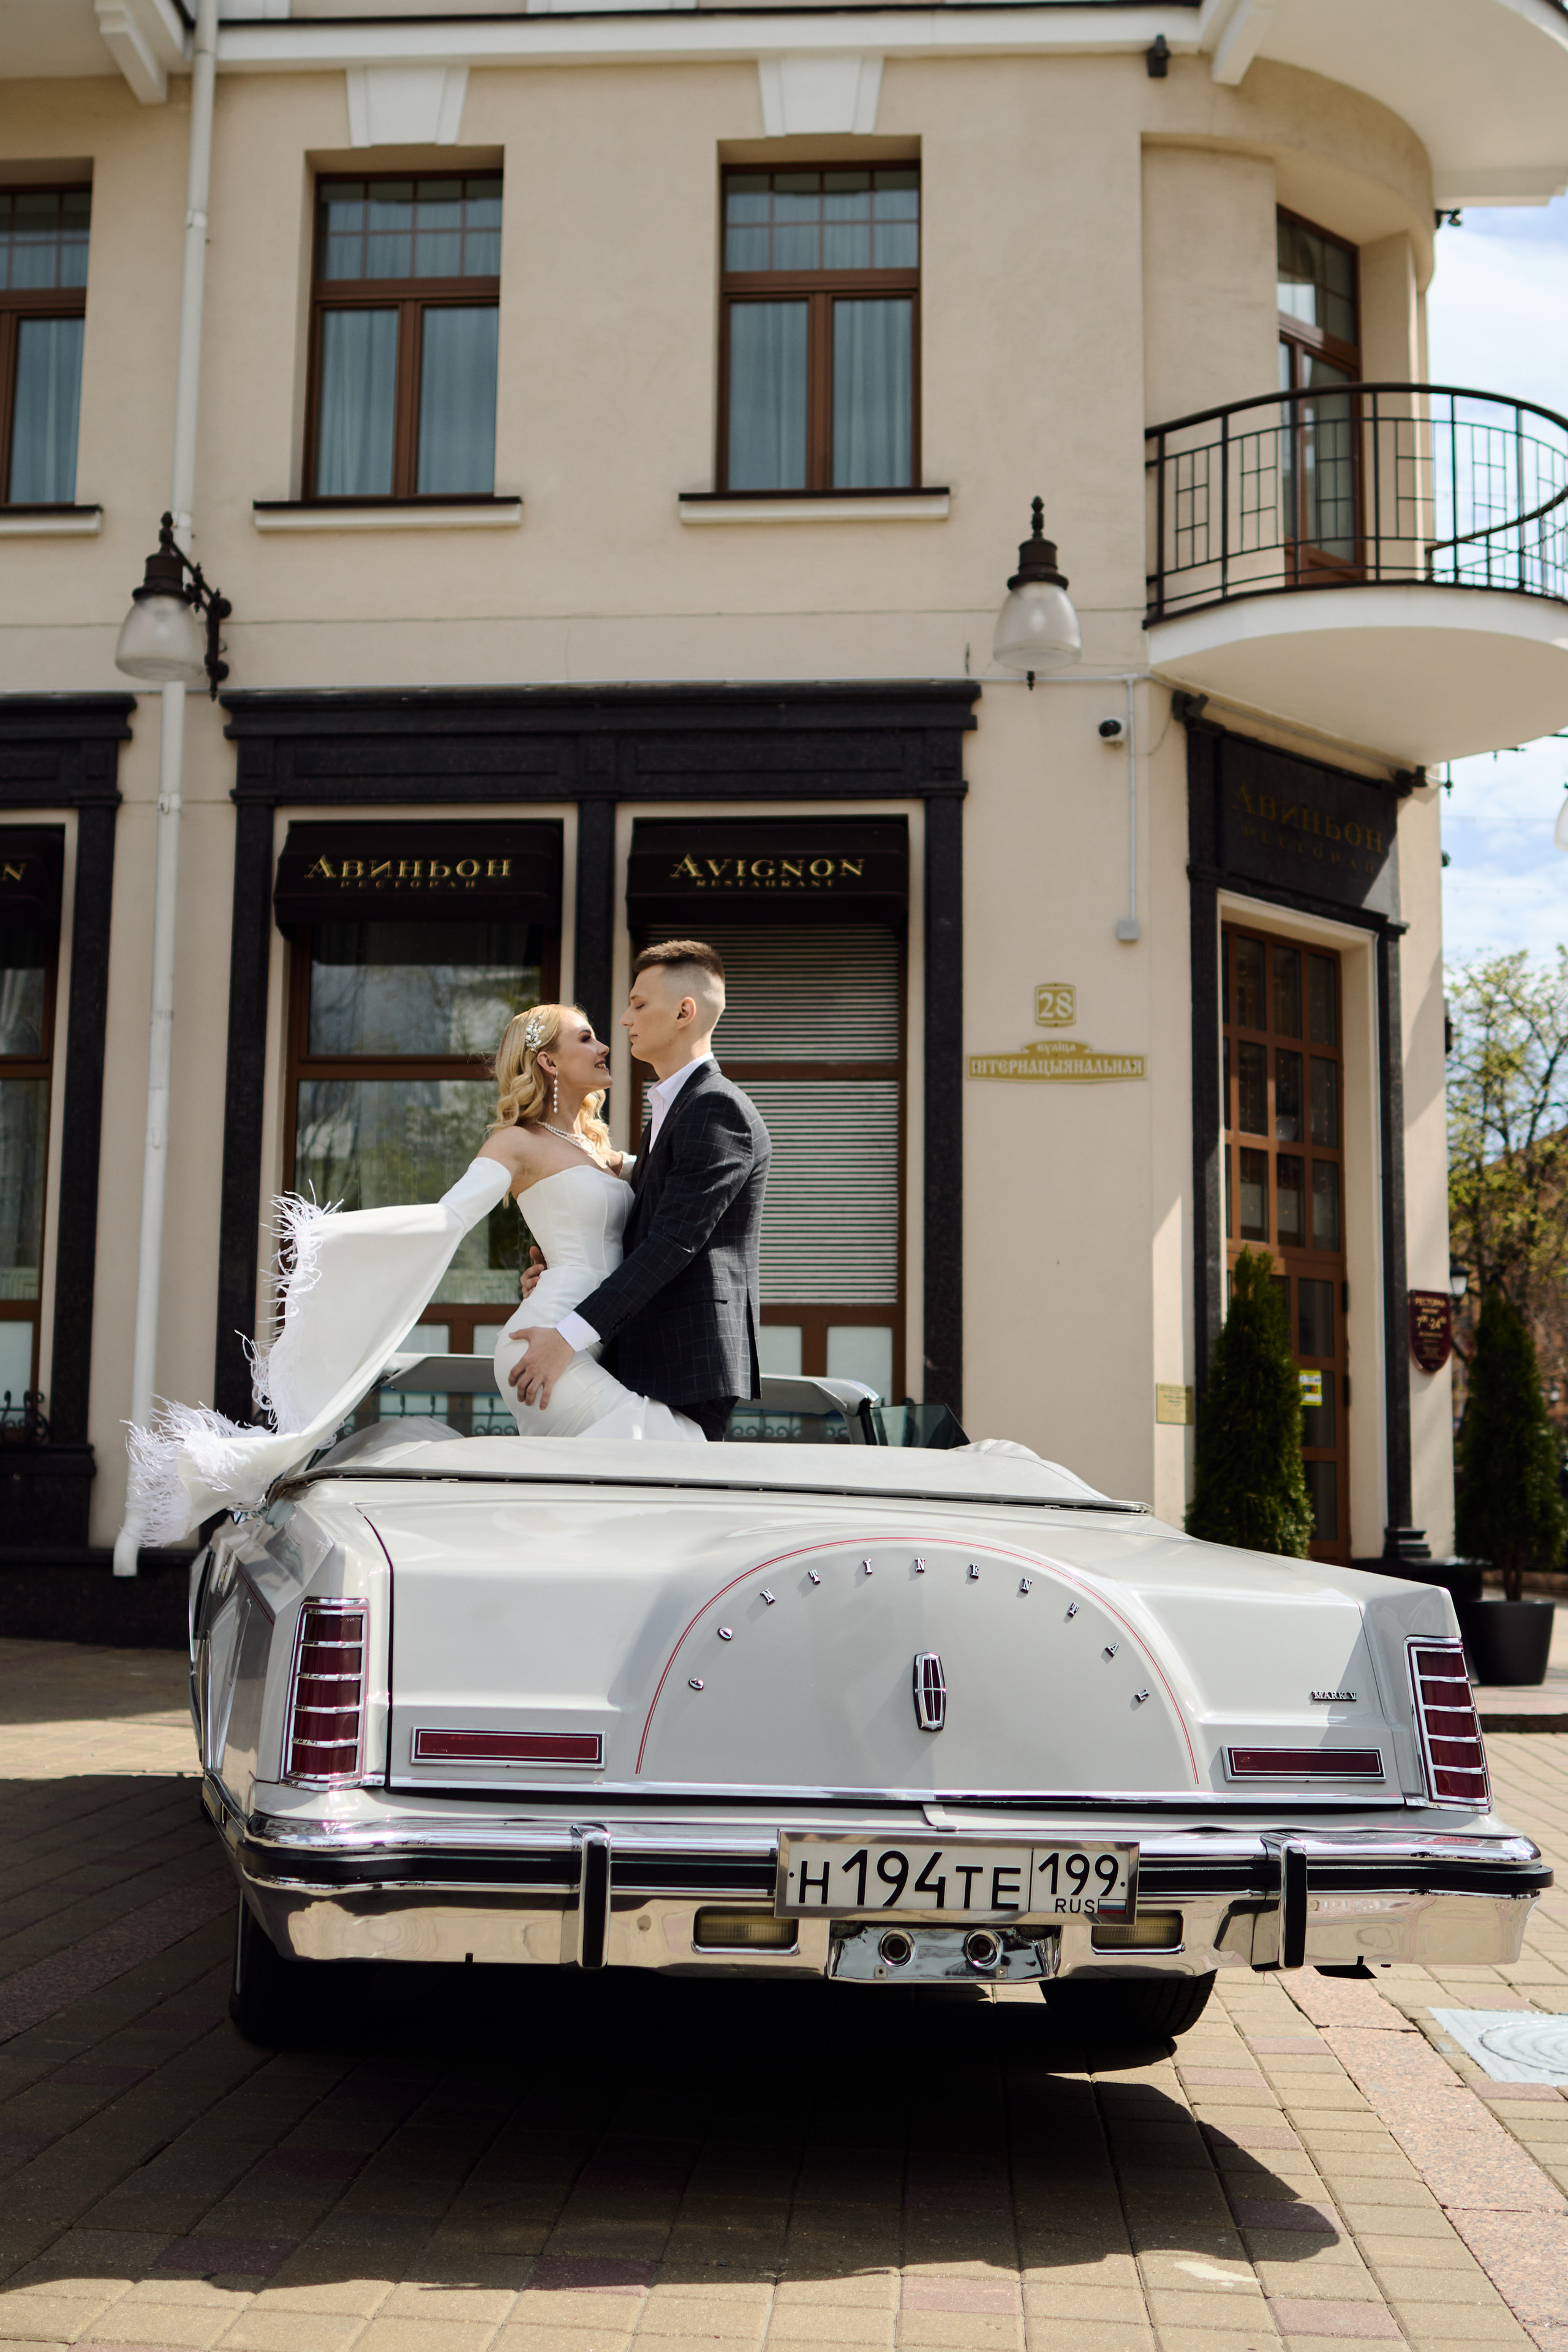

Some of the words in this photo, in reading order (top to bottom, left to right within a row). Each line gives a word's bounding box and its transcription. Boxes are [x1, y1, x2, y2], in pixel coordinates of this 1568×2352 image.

[304, 854, 513, 878] АВИНЬОН
[669, 853, 865, 878] AVIGNON
[1039, 992, 1072, 1019] 28
[688, 1557, 1150, 1703] CONTINENTAL
[1311, 1691, 1347, 1701] MARK
[1038, 1852, 1120, 1896] 199
[1055, 1898, 1095, 1914] RUS
